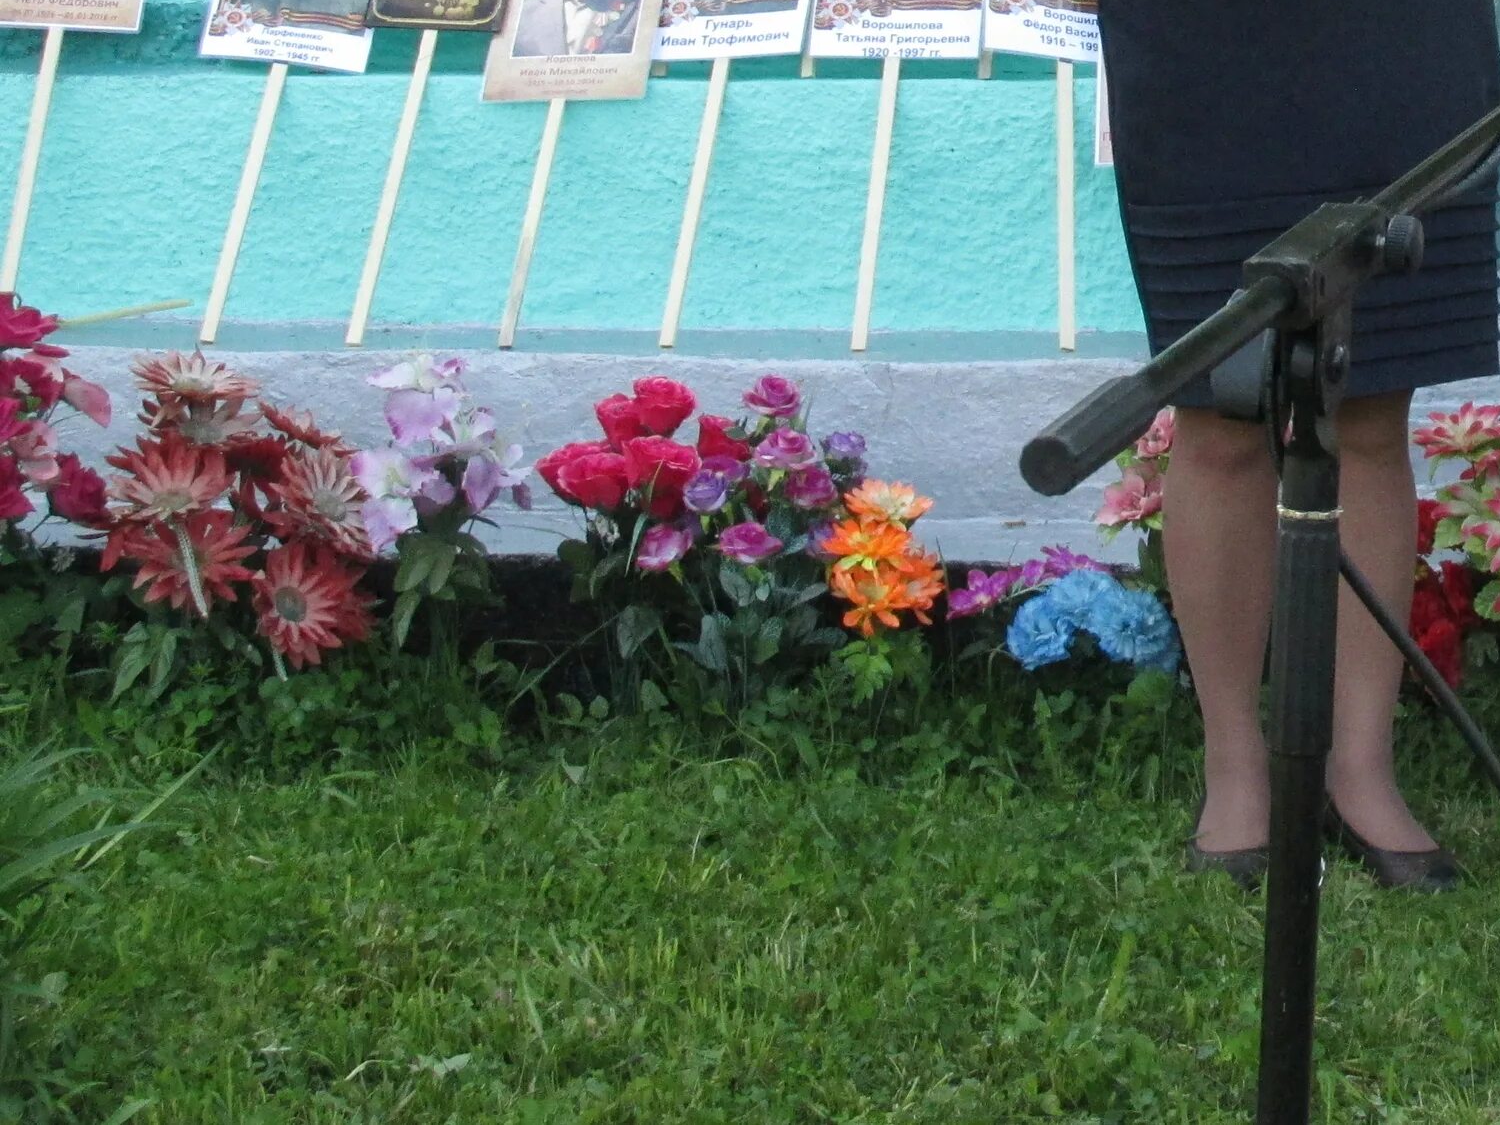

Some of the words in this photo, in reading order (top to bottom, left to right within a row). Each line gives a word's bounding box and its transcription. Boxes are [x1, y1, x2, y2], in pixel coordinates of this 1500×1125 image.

[861, 19, 943, 31] Ворошилова
[1043, 8, 1099, 26] Ворошил
[705, 19, 753, 32] Гунарь
[1022, 18, 1063, 34] Фёдор
[246, 36, 271, 46] Иван
[273, 38, 334, 54] Степанович
[660, 35, 697, 47] Иван
[701, 31, 790, 48] Трофимович
[835, 32, 886, 43] Татьяна
[890, 33, 971, 46] Григорьевна
[1039, 34, 1066, 47] 1916
[1079, 41, 1099, 52] 199
